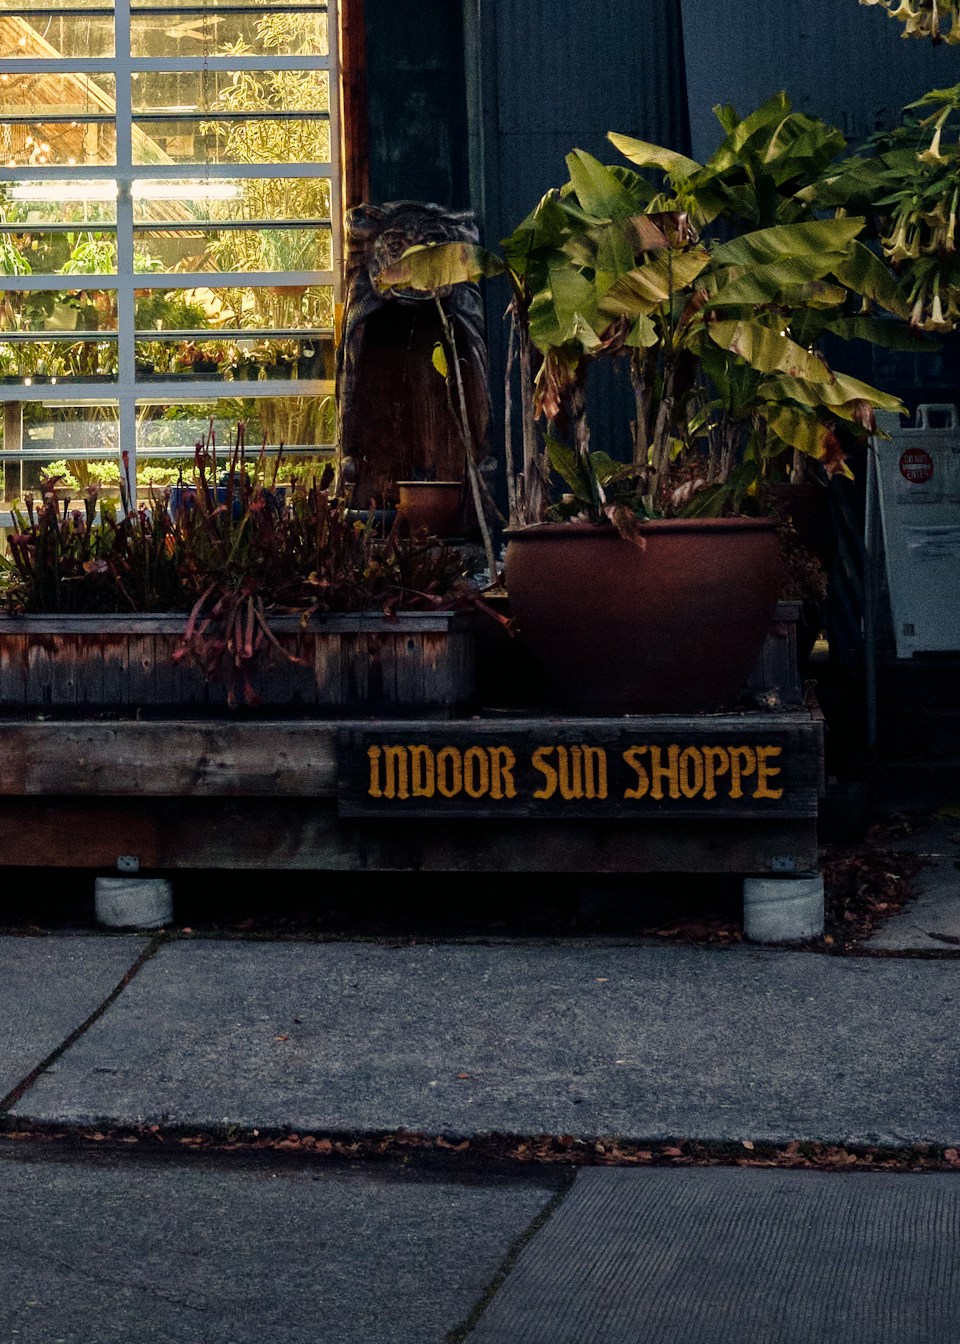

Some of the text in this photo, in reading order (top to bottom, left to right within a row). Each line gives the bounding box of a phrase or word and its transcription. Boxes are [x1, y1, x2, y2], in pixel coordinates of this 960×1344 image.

[907, 470, 928, 479] ENTER
[367, 745, 783, 800] INDOOR SUN SHOPPE
